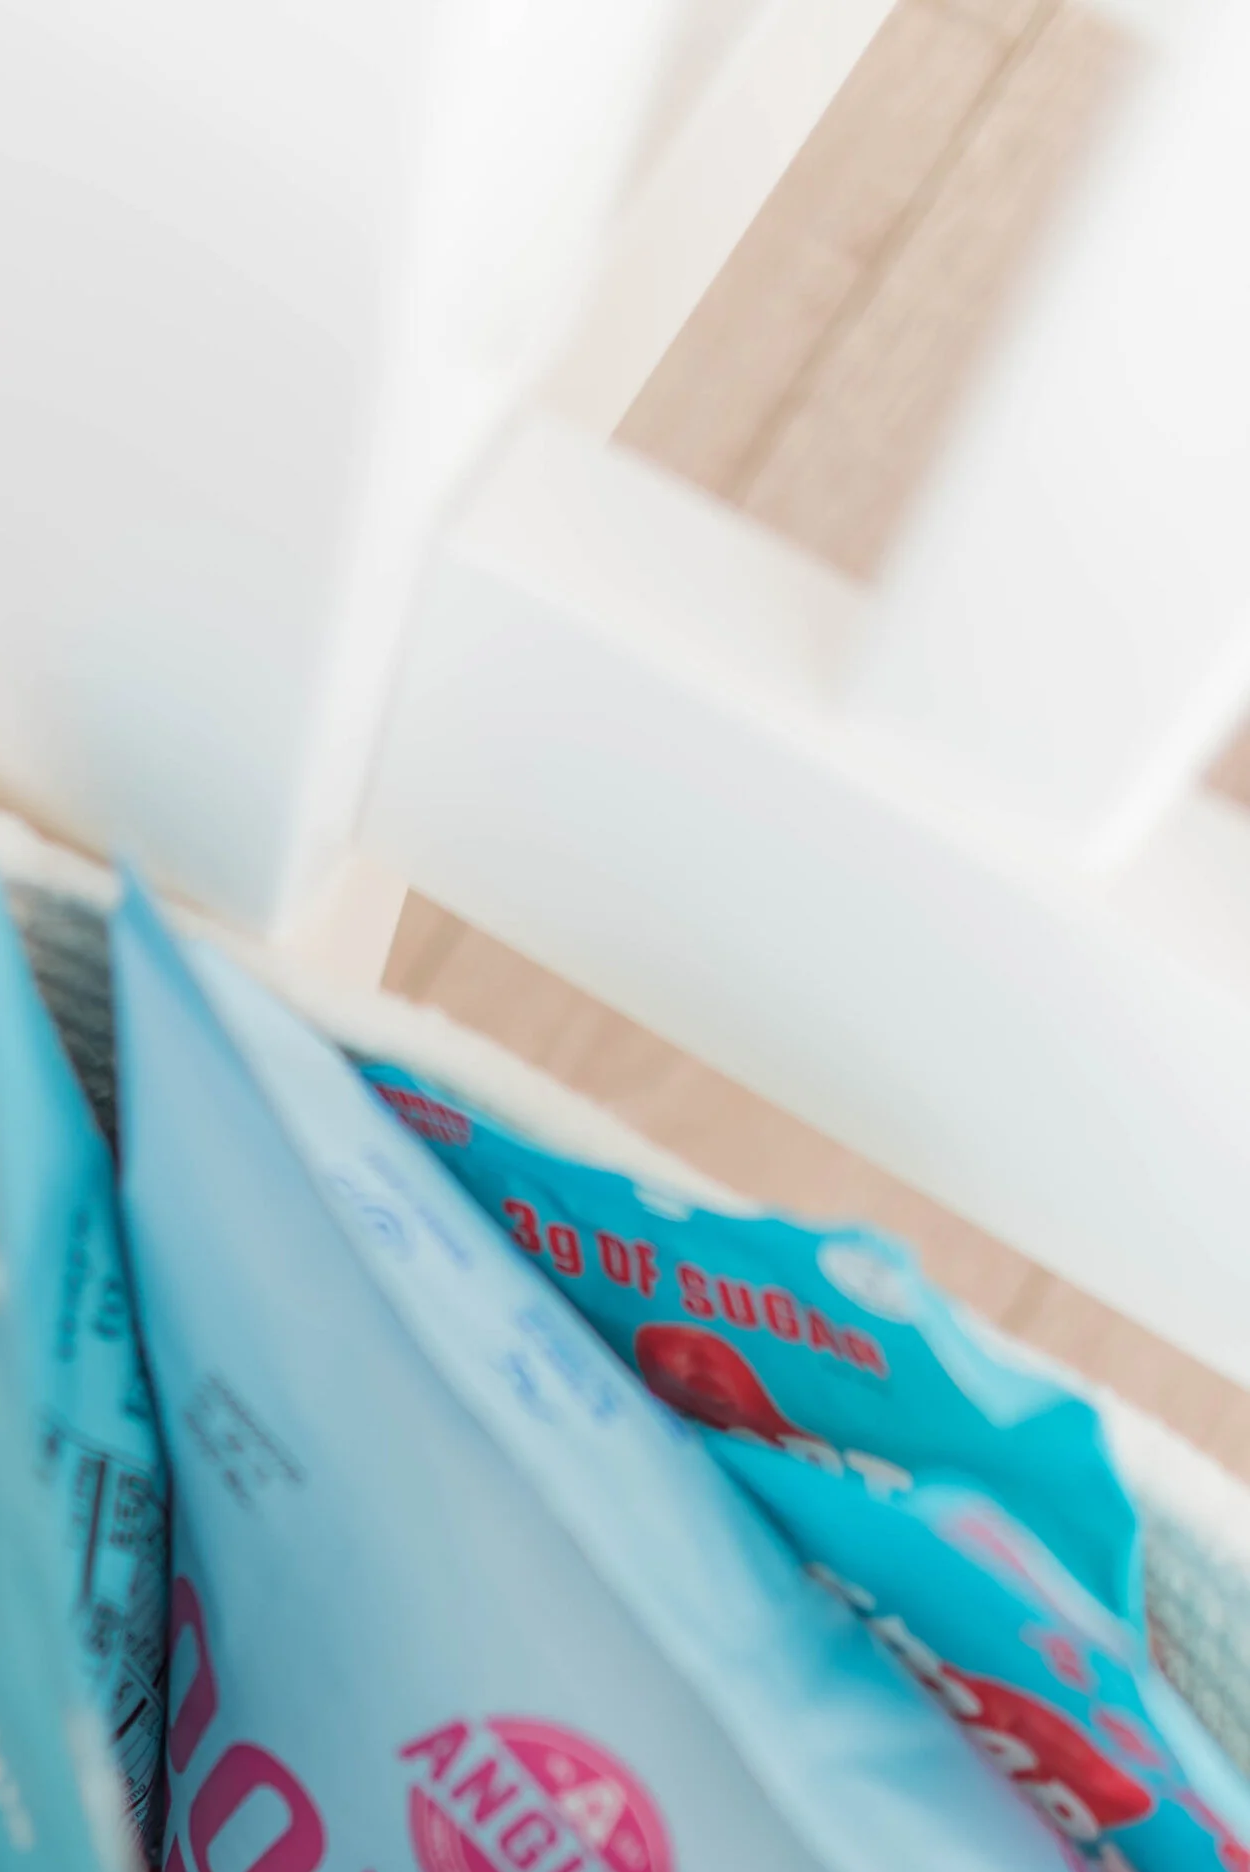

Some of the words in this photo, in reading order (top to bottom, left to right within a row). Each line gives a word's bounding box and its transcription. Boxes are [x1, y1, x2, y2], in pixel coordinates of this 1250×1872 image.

[503, 1200, 584, 1278] 3g
[596, 1231, 659, 1298] OF
[677, 1262, 889, 1379] SUGAR
